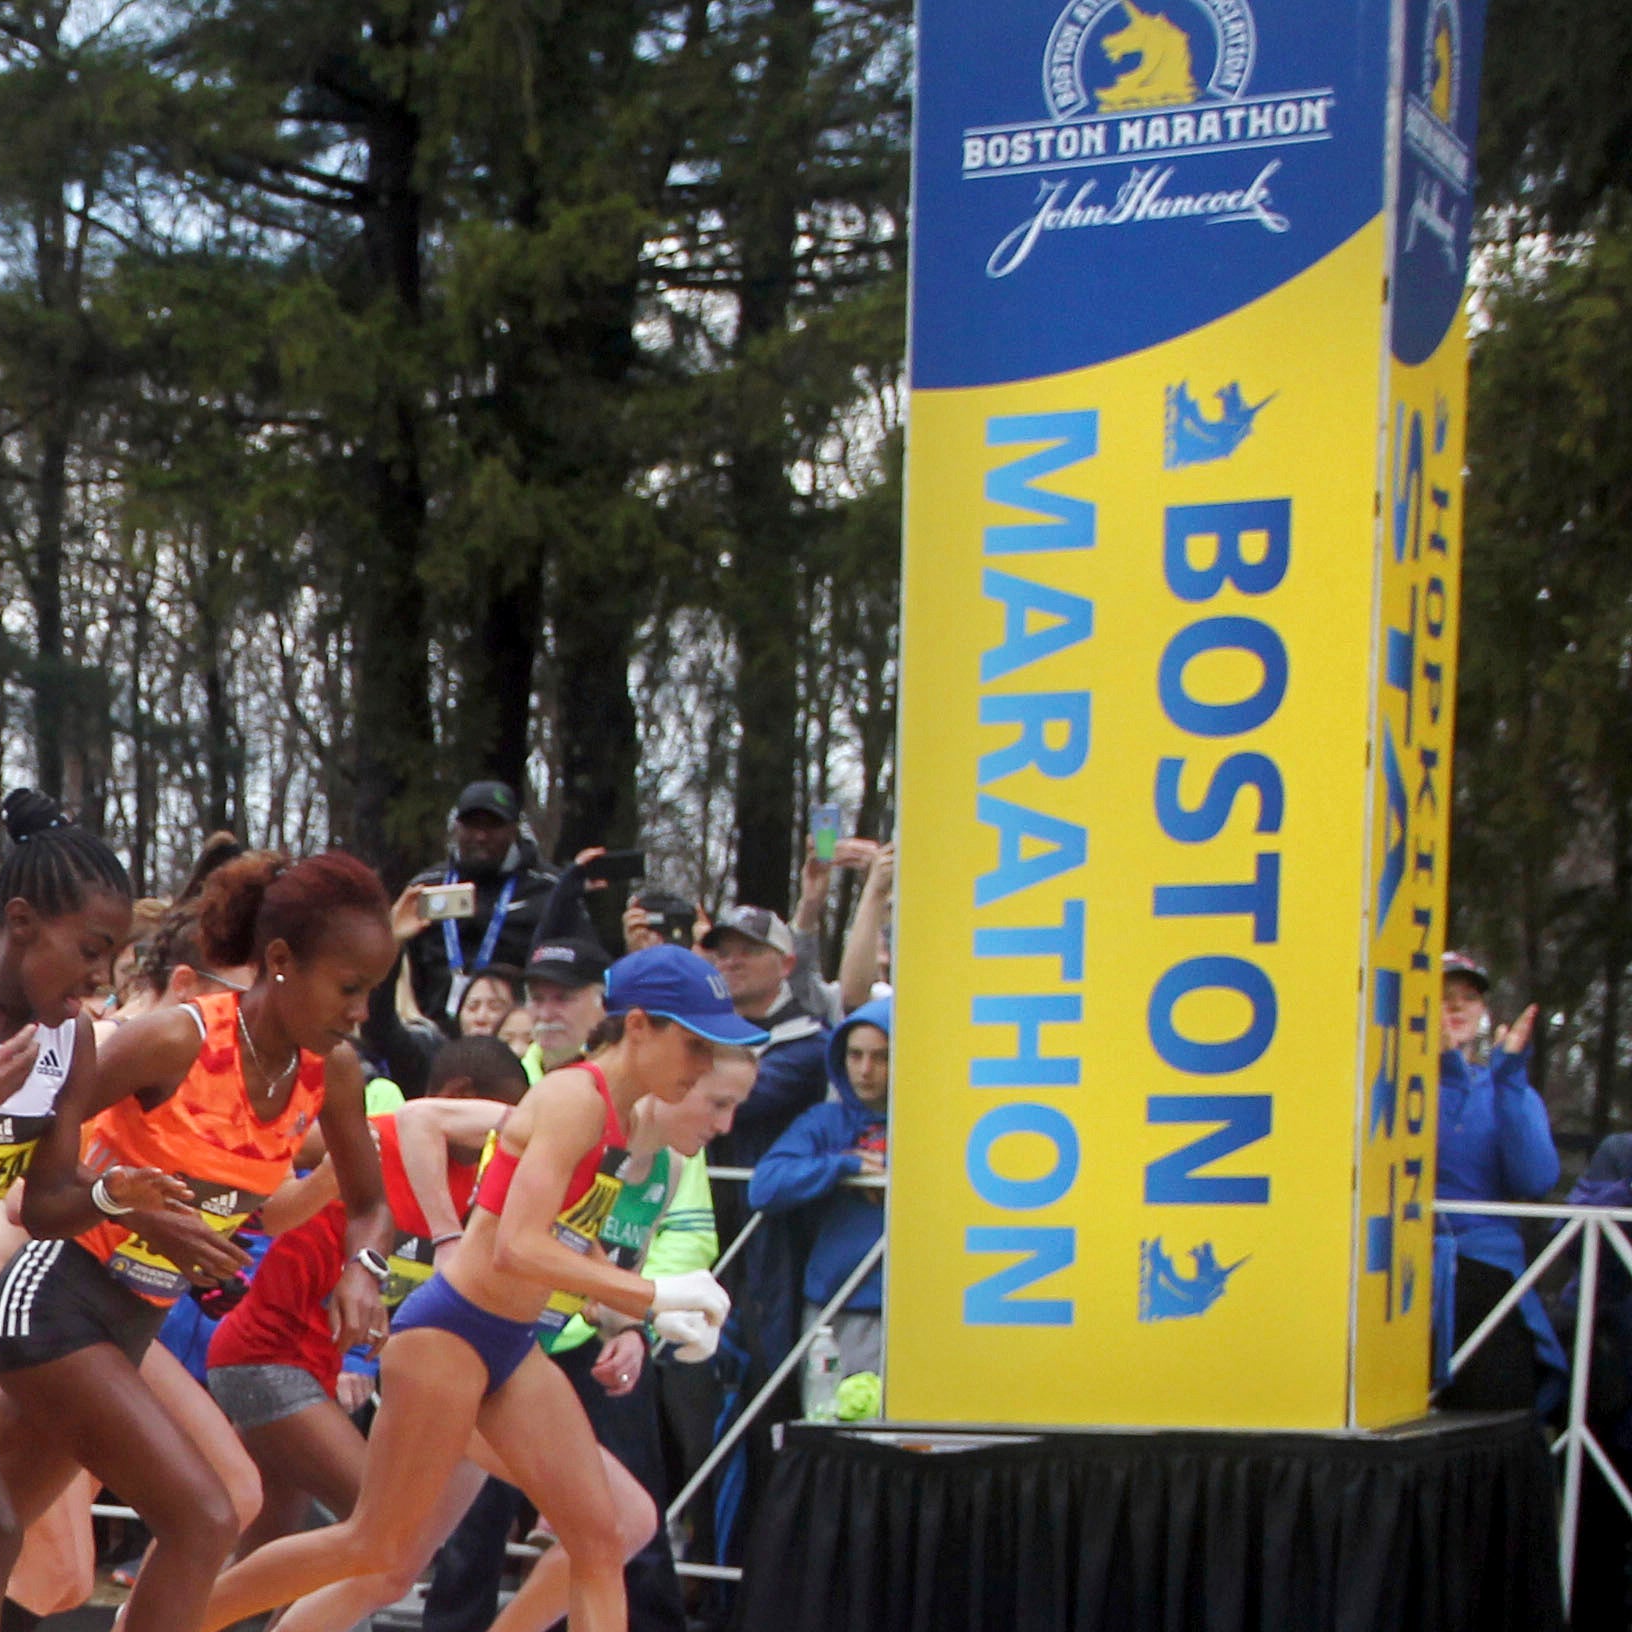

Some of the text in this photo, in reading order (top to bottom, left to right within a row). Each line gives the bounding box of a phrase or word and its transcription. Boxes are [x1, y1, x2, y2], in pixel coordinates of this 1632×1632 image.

[962, 97, 1329, 170] BOSTON MARATHON
[985, 157, 1291, 279] John Hancock
[962, 408, 1100, 1325] MARATHON
[1143, 497, 1292, 1205] BOSTON
[1364, 400, 1423, 1323] START
[1402, 486, 1450, 1222] HOPKINTON
